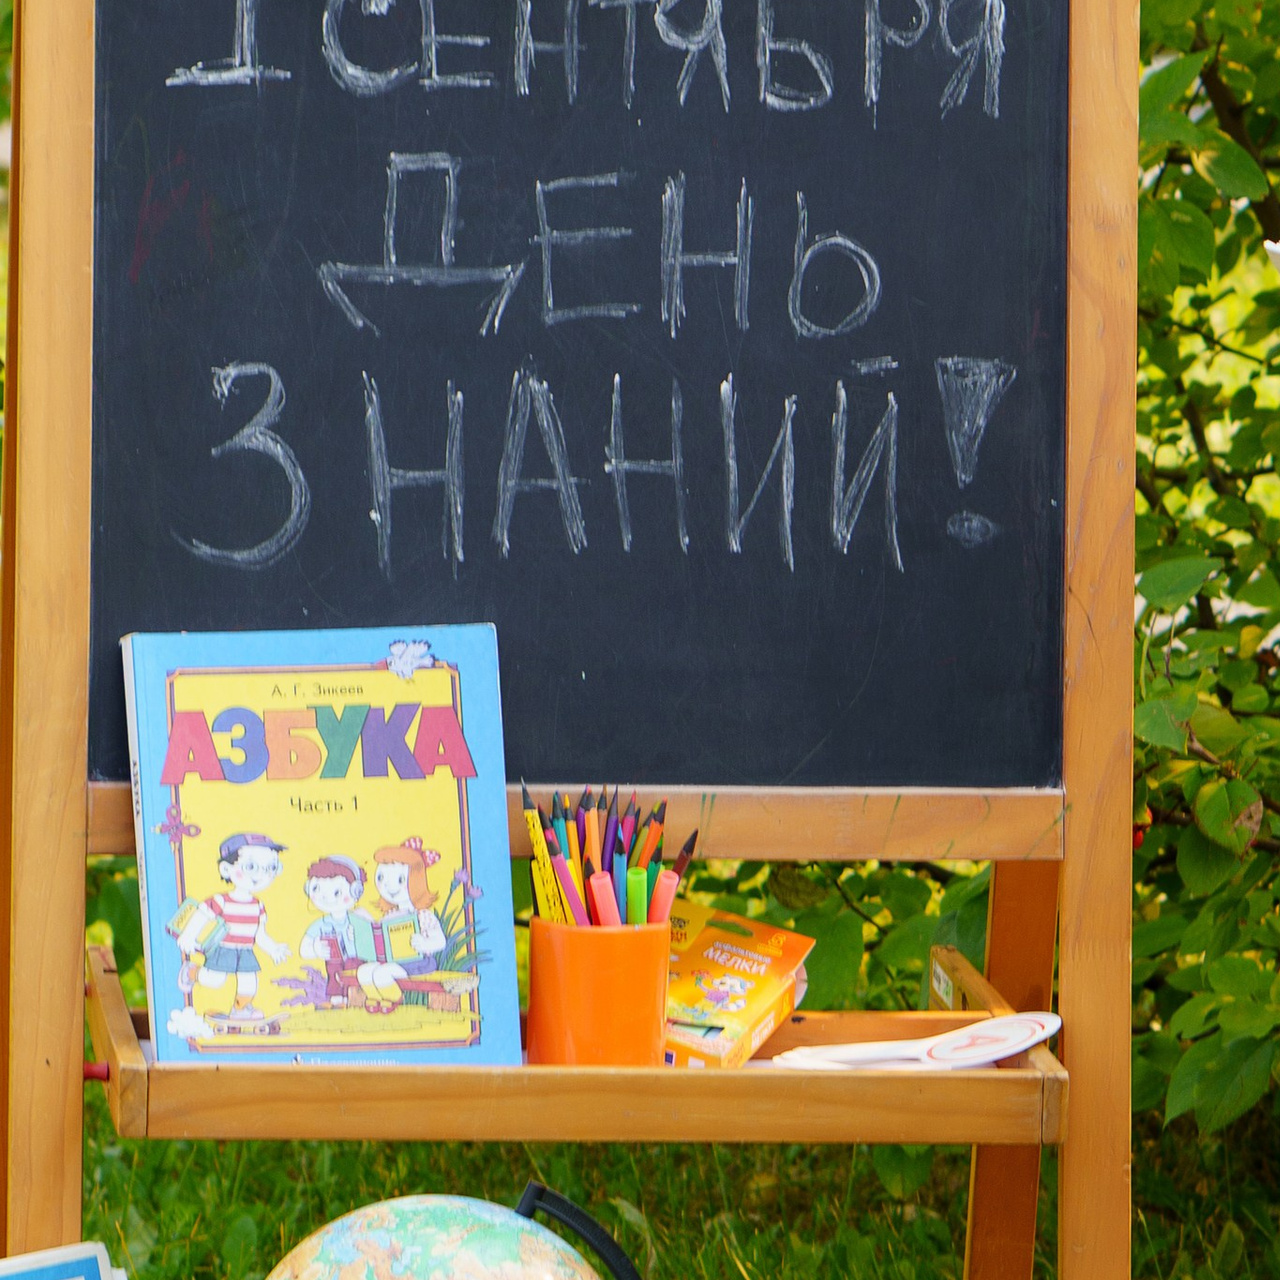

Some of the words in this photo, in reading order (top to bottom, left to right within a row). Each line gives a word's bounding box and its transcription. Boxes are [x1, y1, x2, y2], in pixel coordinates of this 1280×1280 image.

[316, 150, 883, 339] ДЕНЬ
[168, 354, 1018, 579] ЗНАНИЙ!
[160, 702, 478, 786] АЗБУКА
[289, 794, 345, 814] Часть
[352, 794, 360, 812] 1
